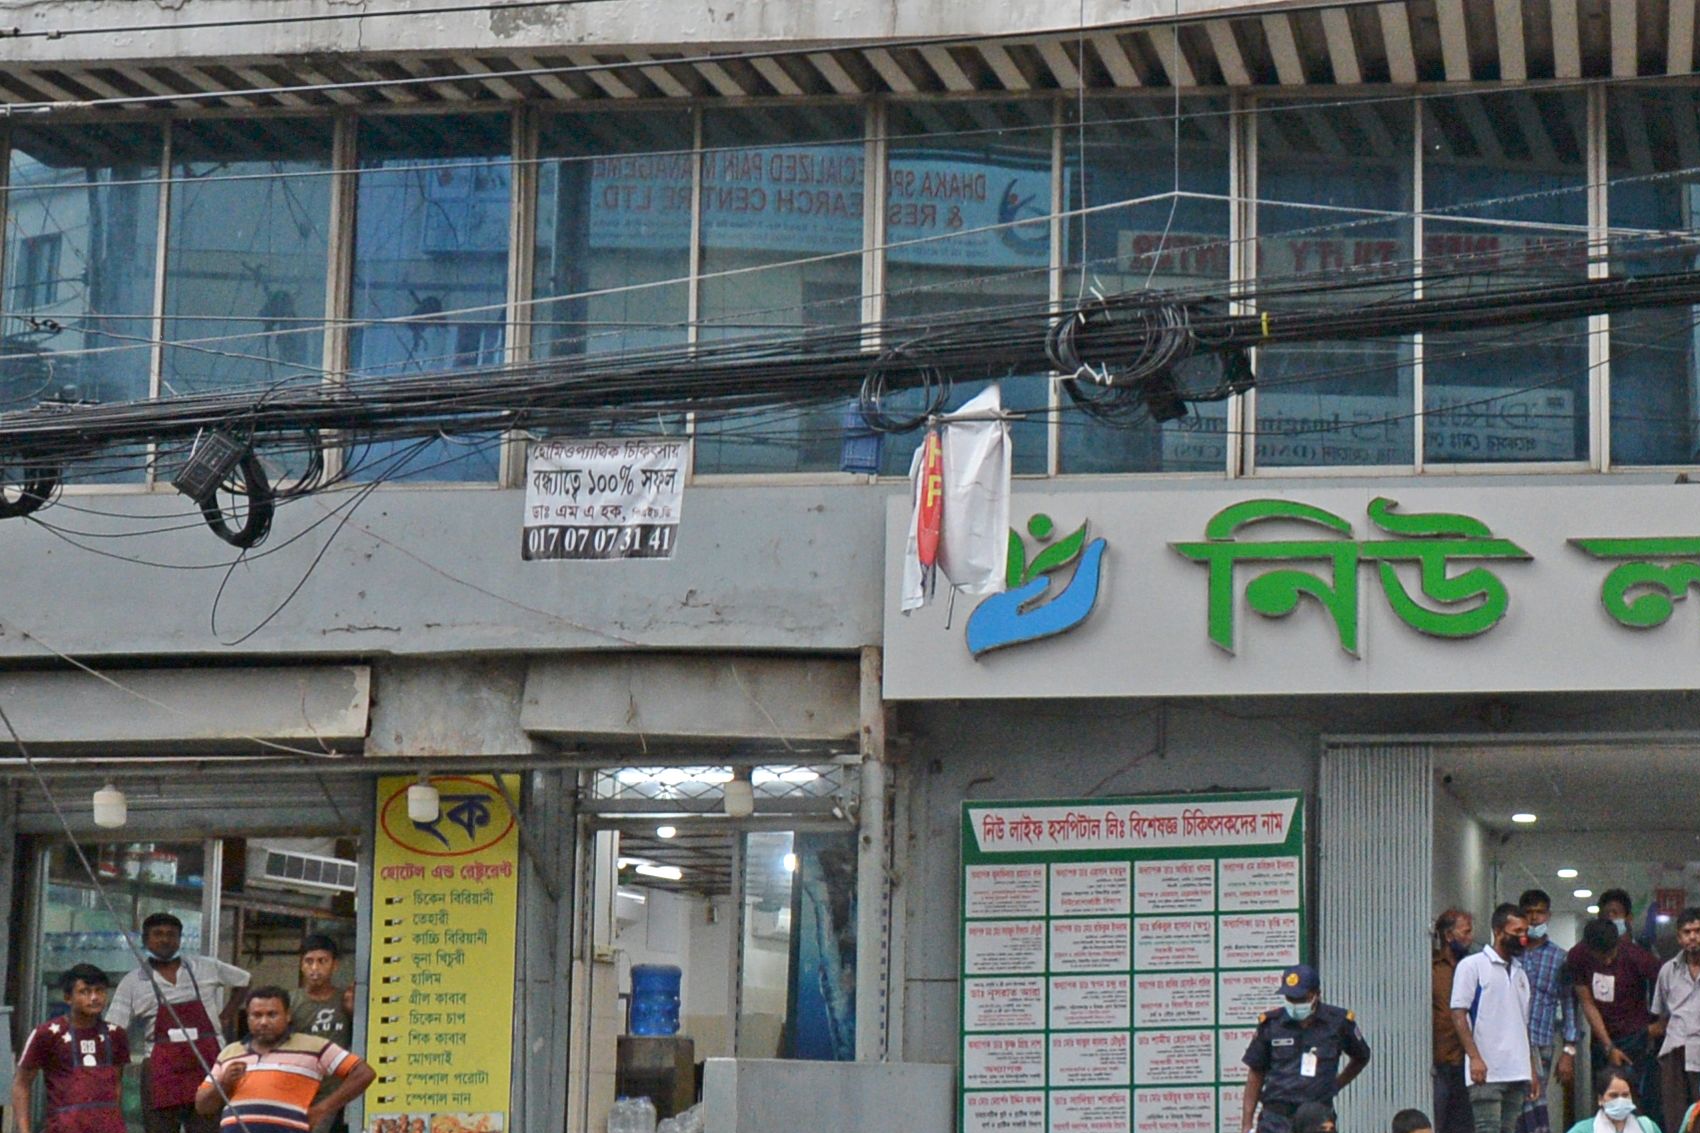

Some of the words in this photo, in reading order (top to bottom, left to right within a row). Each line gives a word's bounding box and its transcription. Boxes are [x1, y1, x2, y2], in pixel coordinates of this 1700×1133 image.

[587, 463, 635, 497] ১০০%
[640, 468, 678, 495] সফল
[555, 505, 580, 520] এম
[583, 505, 596, 520] এ
[528, 527, 559, 553] 017
[564, 527, 590, 552] 07
[594, 527, 620, 551] 07
[619, 527, 642, 551] 31
[648, 527, 671, 551] 41
[1166, 496, 1535, 661] নিউ
[982, 814, 1005, 843] নিউ
[1009, 813, 1043, 844] লাইফ
[1047, 811, 1101, 844] হসপিটাল
[1105, 811, 1126, 841] লিঃ
[1129, 809, 1179, 840] বিশেষজ্ঞ
[1182, 808, 1258, 838] চিকিৎসকদের
[1261, 811, 1284, 837] নাম
[413, 889, 446, 905] চিকেন
[410, 970, 441, 985] হালিম
[435, 992, 467, 1005] কাবাব
[409, 1010, 441, 1025] চিকেন
[446, 1010, 466, 1025] চাপ
[435, 1032, 467, 1045] কাবাব
[452, 1092, 472, 1107] নান
